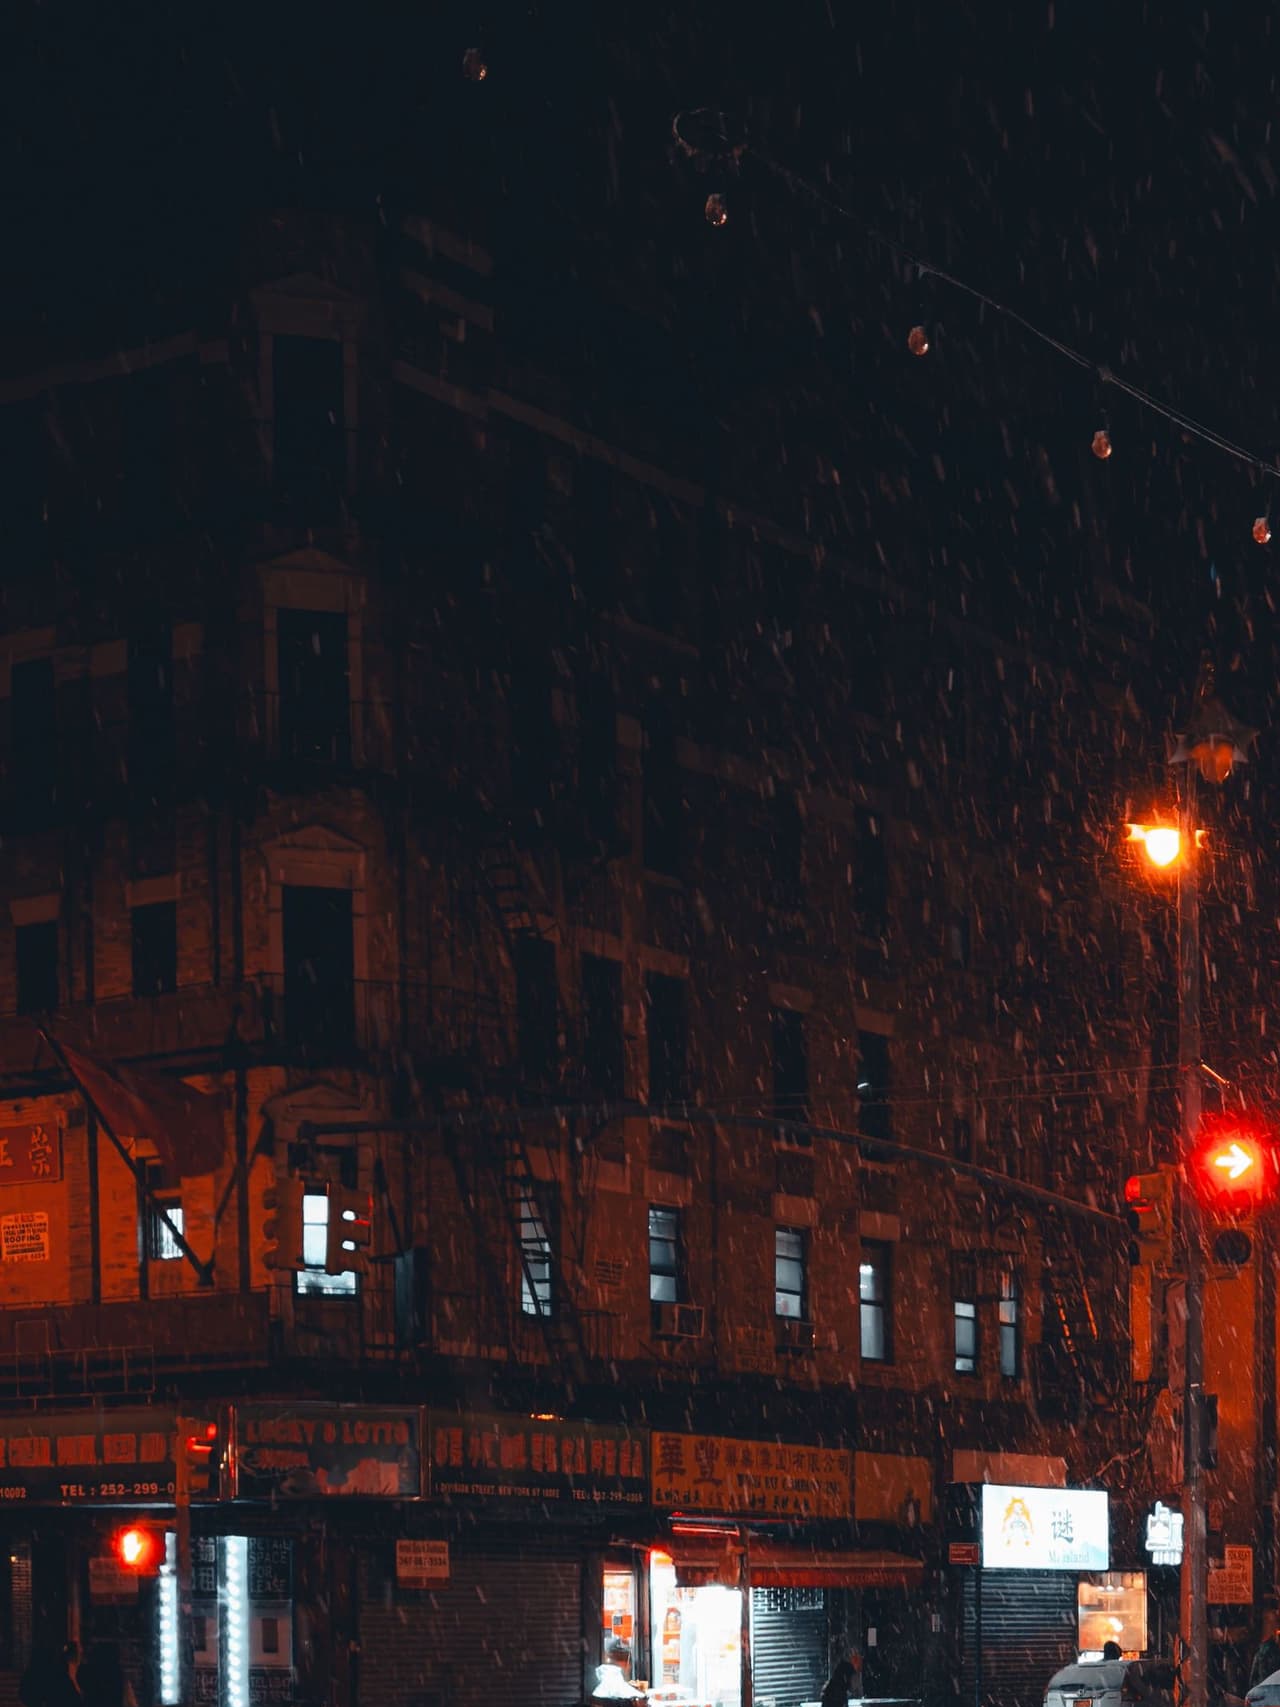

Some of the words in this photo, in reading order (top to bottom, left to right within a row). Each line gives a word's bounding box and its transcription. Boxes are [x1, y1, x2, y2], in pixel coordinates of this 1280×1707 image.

[343, 1419, 410, 1445] LOTTO
[250, 1551, 288, 1564] SPACE
[250, 1565, 273, 1579] FOR
